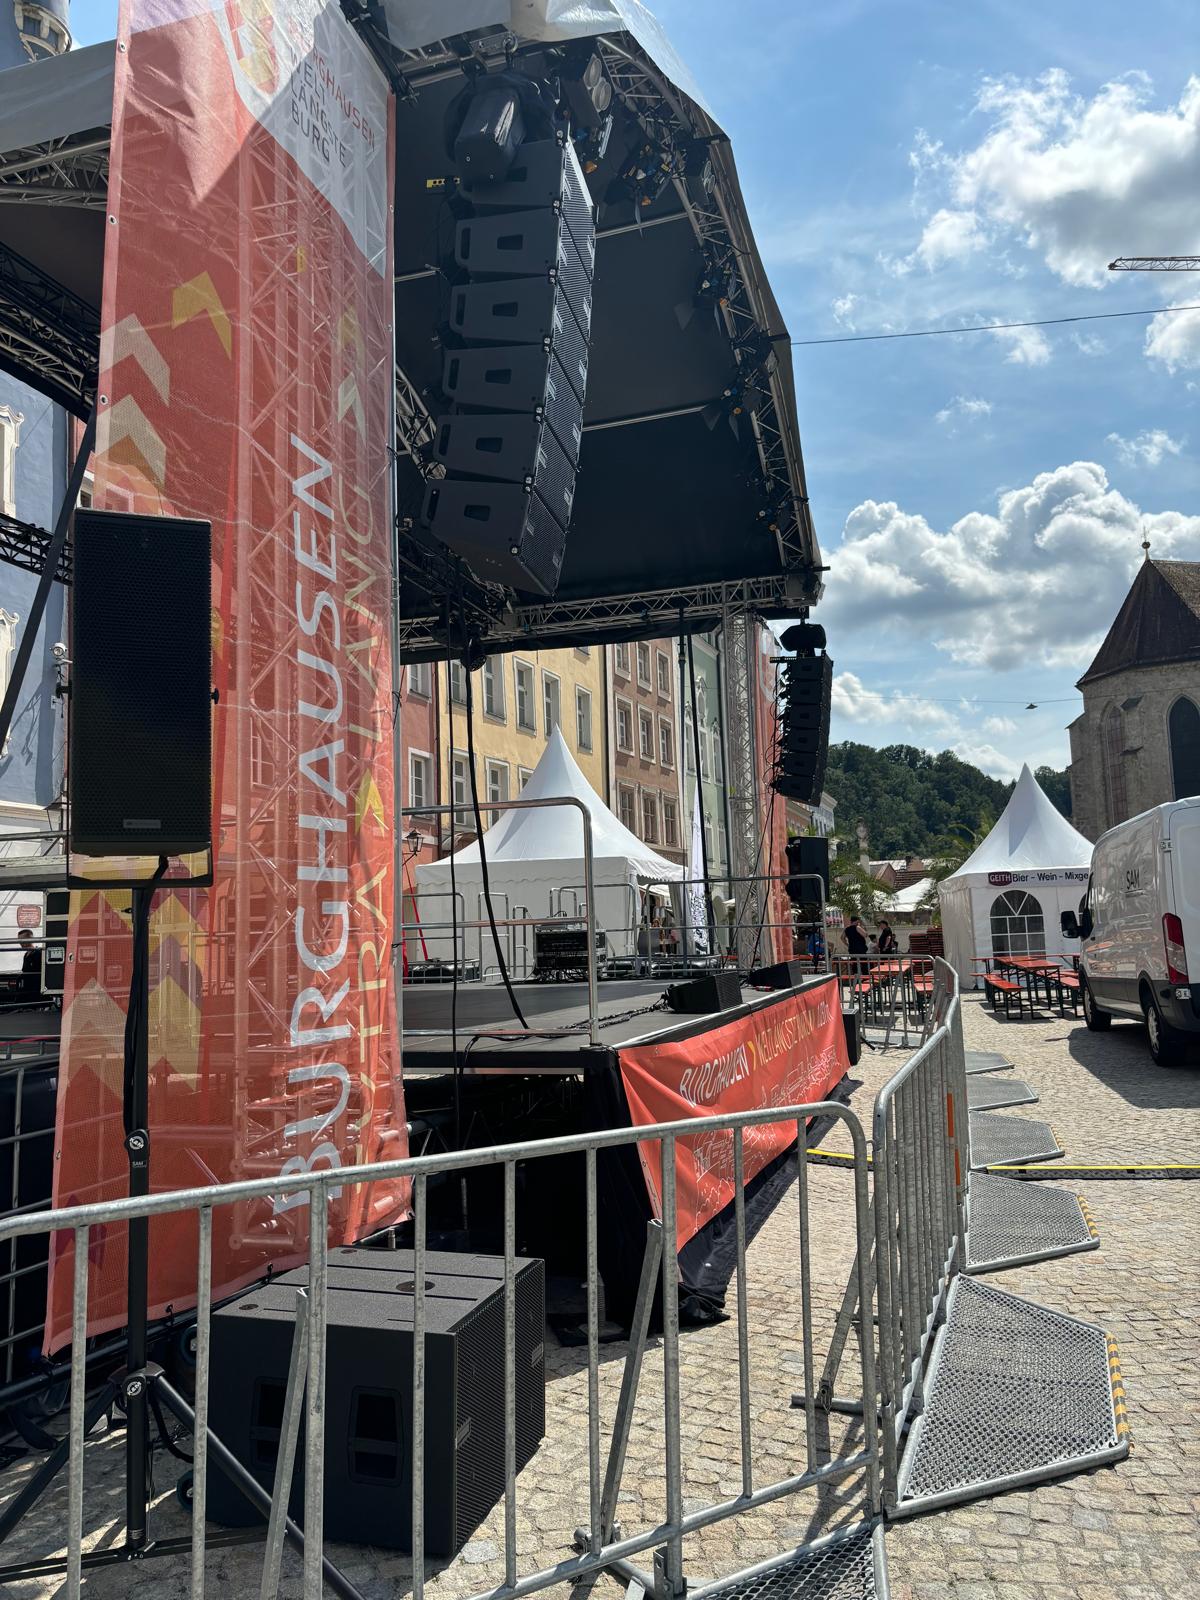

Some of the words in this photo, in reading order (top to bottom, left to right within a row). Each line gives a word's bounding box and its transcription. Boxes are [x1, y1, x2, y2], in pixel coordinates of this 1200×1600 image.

[290, 72, 347, 168] LÄNGSTE
[291, 98, 331, 163] BURG
[272, 432, 352, 1215] BURGHAUSEN
[989, 874, 1010, 882] GEITH
[1012, 873, 1029, 882] Bier
[1037, 872, 1058, 881] Wein
[1126, 869, 1140, 890] SAM
